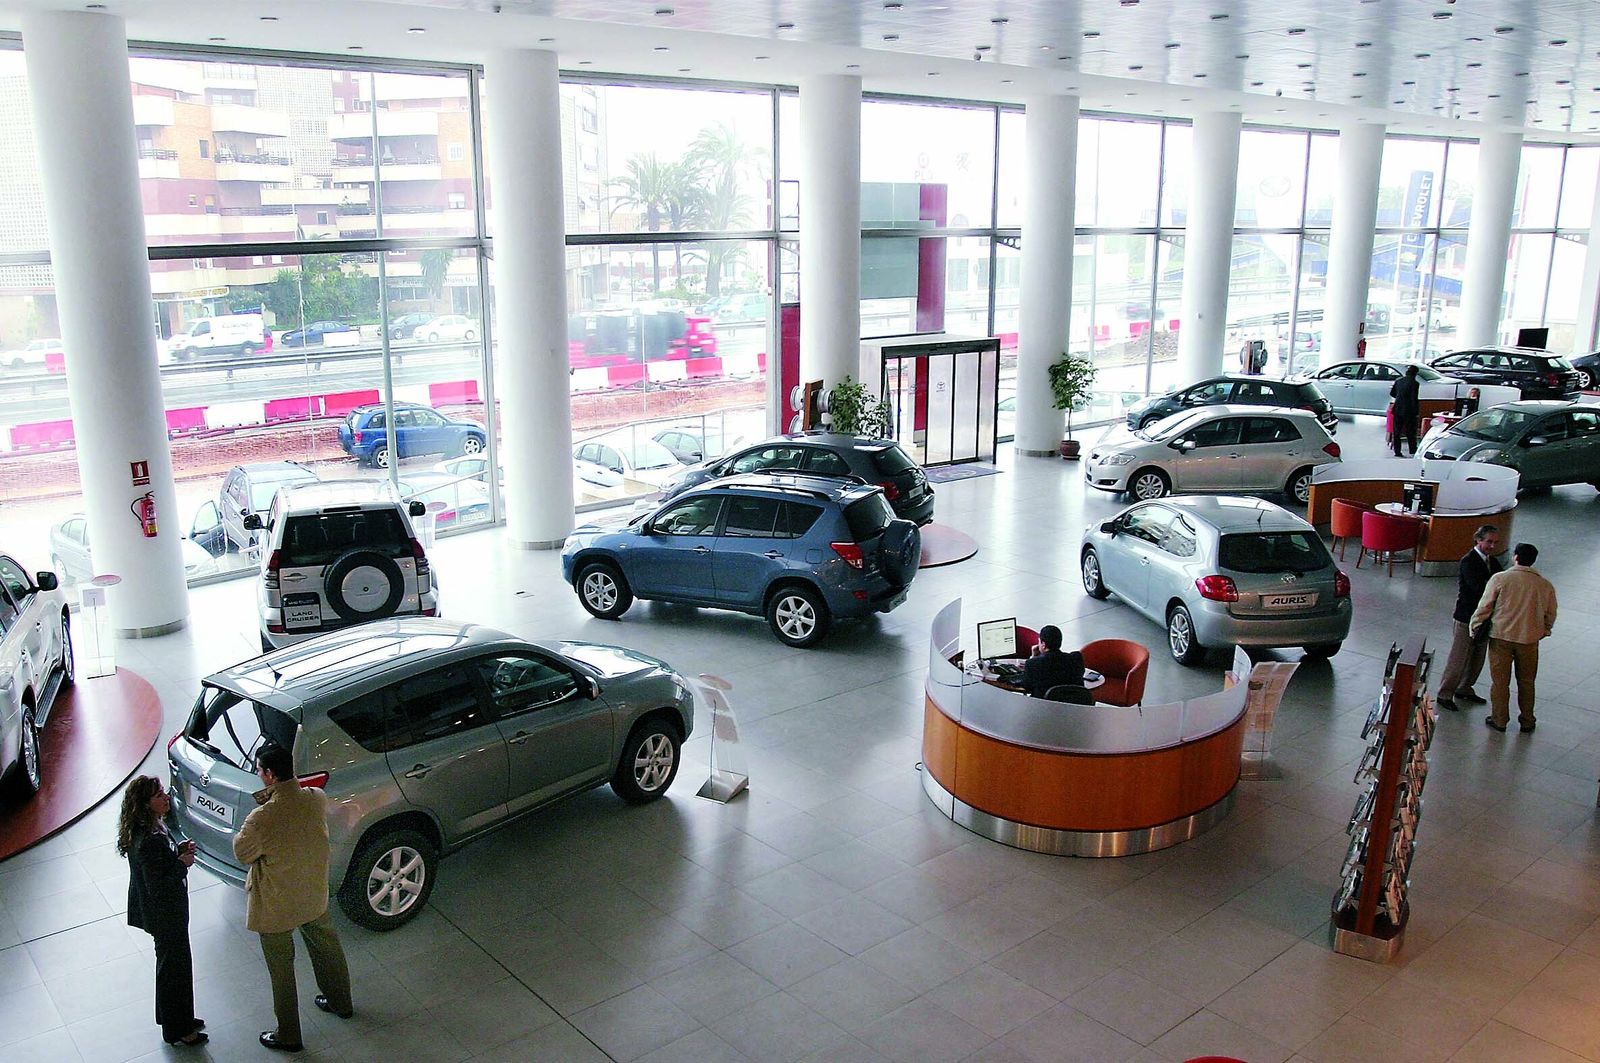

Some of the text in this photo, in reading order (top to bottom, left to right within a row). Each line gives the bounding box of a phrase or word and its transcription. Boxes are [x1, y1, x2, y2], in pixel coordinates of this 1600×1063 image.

[1407, 175, 1432, 242] CEVROLET
[1271, 596, 1307, 605] AURIS
[196, 795, 225, 816] RAV4
